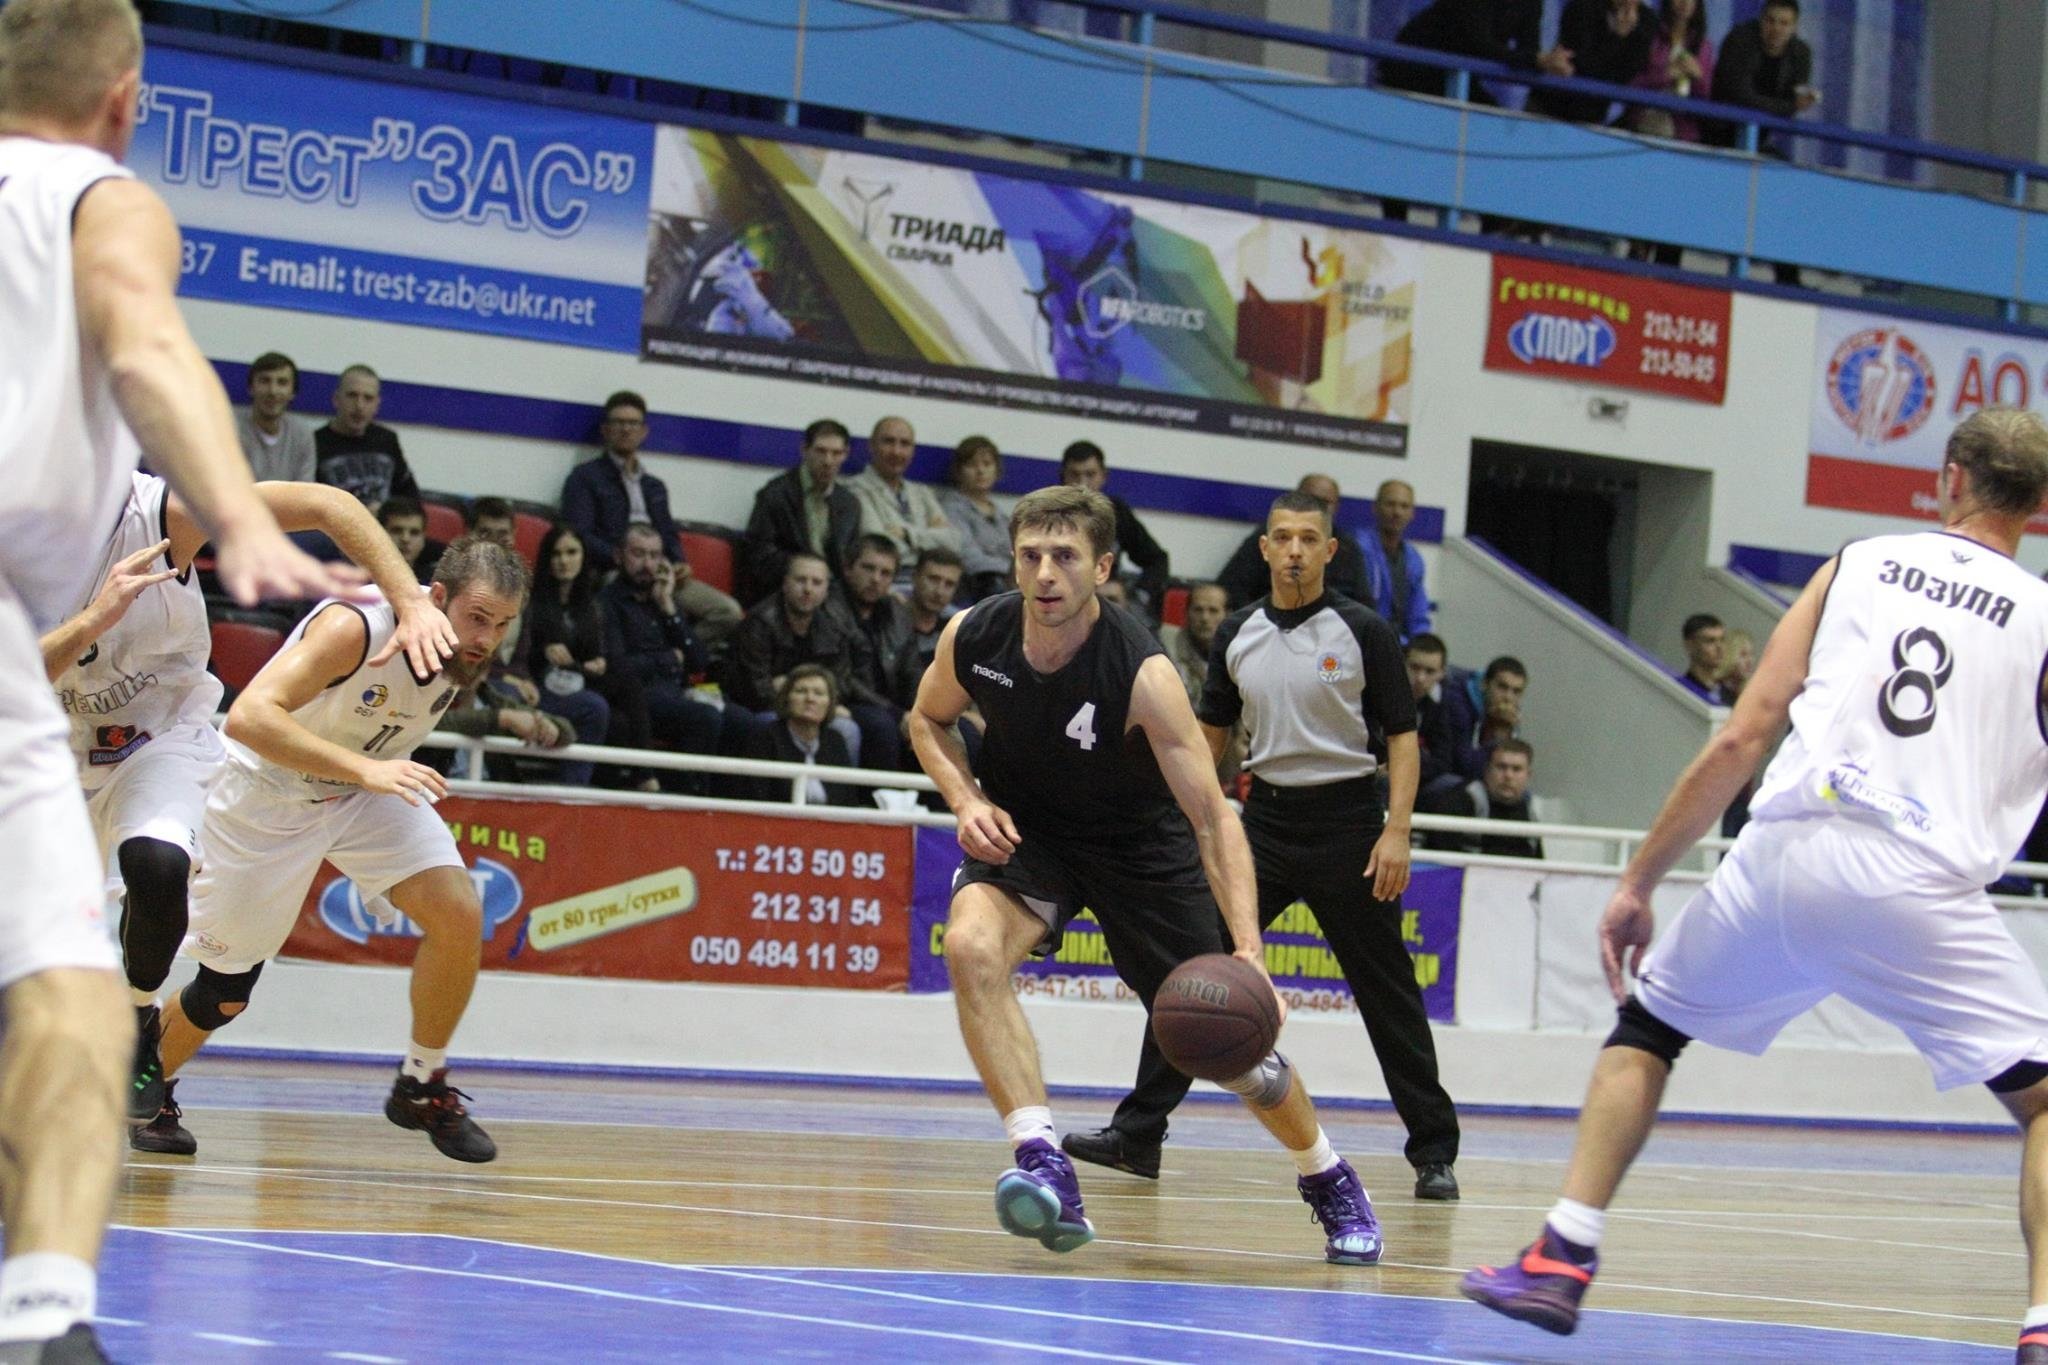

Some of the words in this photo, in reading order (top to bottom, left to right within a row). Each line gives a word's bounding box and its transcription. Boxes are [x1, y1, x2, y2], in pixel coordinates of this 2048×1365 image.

[889, 213, 1007, 254] ТРИАДА
[238, 247, 346, 293] E-mail:
[352, 265, 596, 326] trest-zab@ukr.net
[1522, 313, 1601, 367] СПОРТ
[1878, 558, 2017, 630] ЗОЗУЛЯ
[972, 664, 1014, 688] macron
[1877, 626, 1955, 738] 8
[1065, 701, 1097, 751] 4
[716, 849, 747, 872] т.:
[753, 844, 804, 875] 213
[811, 849, 845, 877] 50
[852, 852, 885, 880] 95
[539, 917, 560, 936] от
[563, 908, 585, 931] 80
[751, 891, 801, 921] 212
[808, 895, 840, 924] 31
[850, 898, 882, 926] 54
[690, 935, 741, 966] 050
[748, 939, 799, 968] 484
[806, 942, 837, 971] 11
[846, 945, 880, 972] 39
